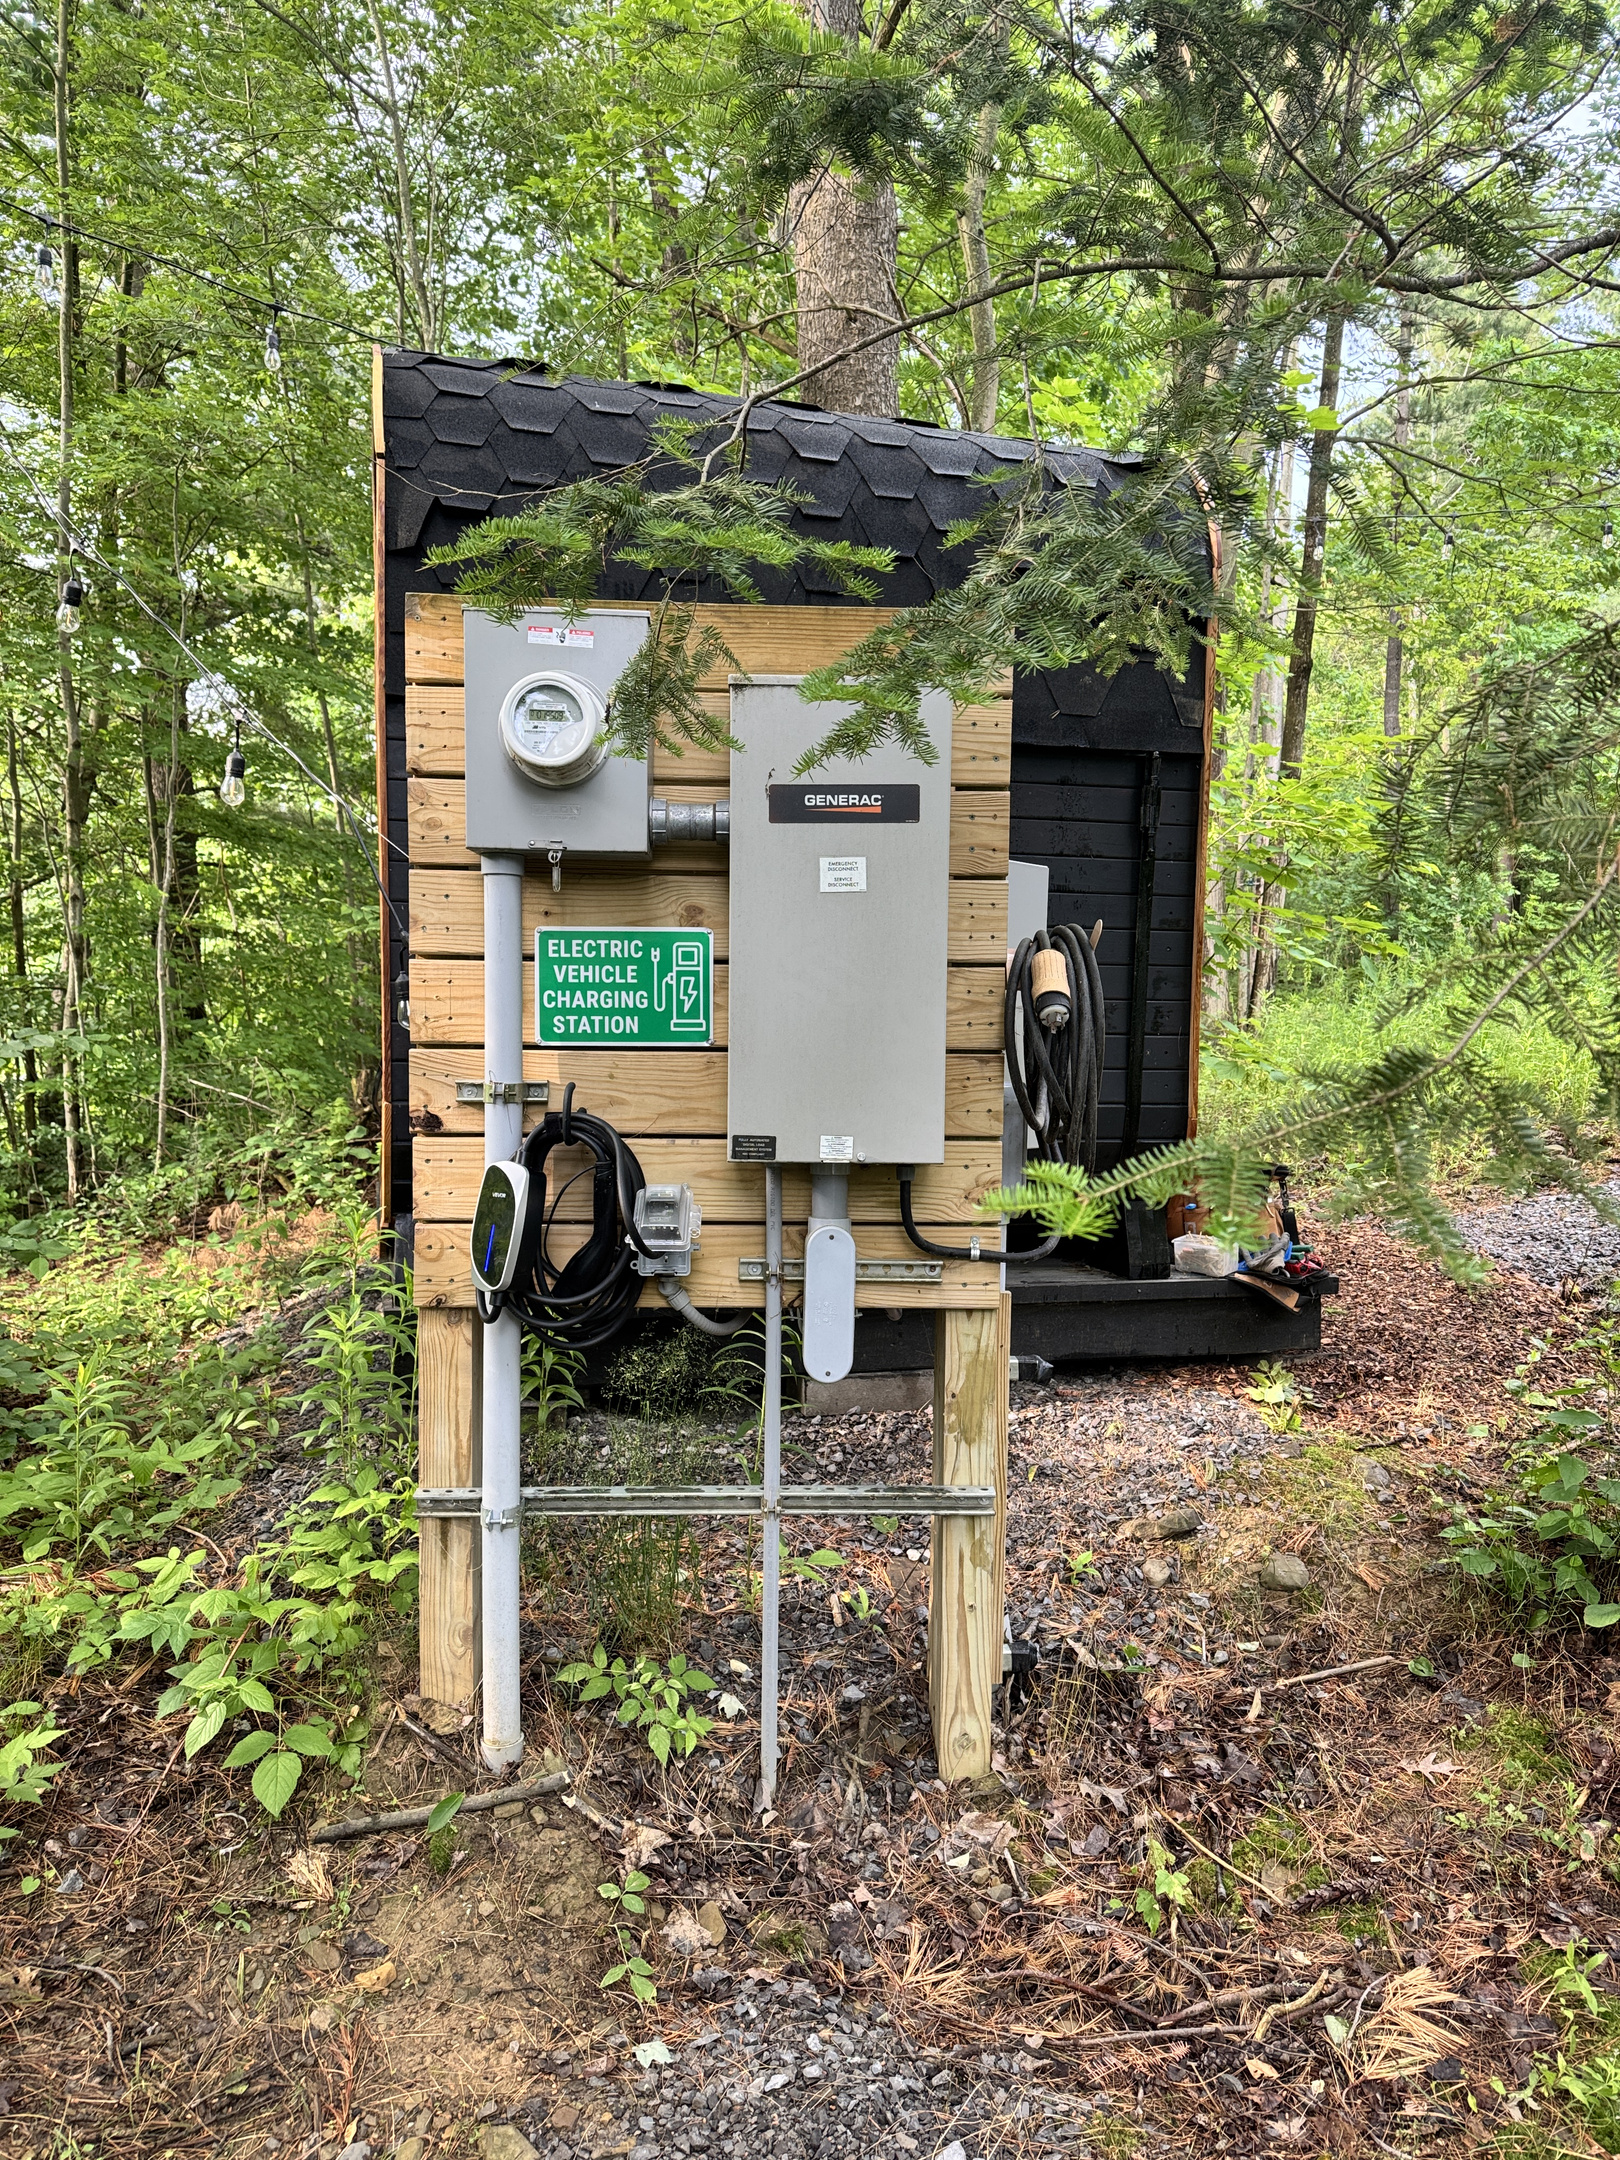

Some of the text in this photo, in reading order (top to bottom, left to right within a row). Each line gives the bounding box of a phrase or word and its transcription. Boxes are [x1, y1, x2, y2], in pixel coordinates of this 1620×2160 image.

[804, 794, 882, 806] GENERAC
[547, 939, 643, 958] ELECTRIC
[553, 965, 638, 983] VEHICLE
[542, 990, 648, 1009] CHARGING
[552, 1015, 639, 1034] STATION
